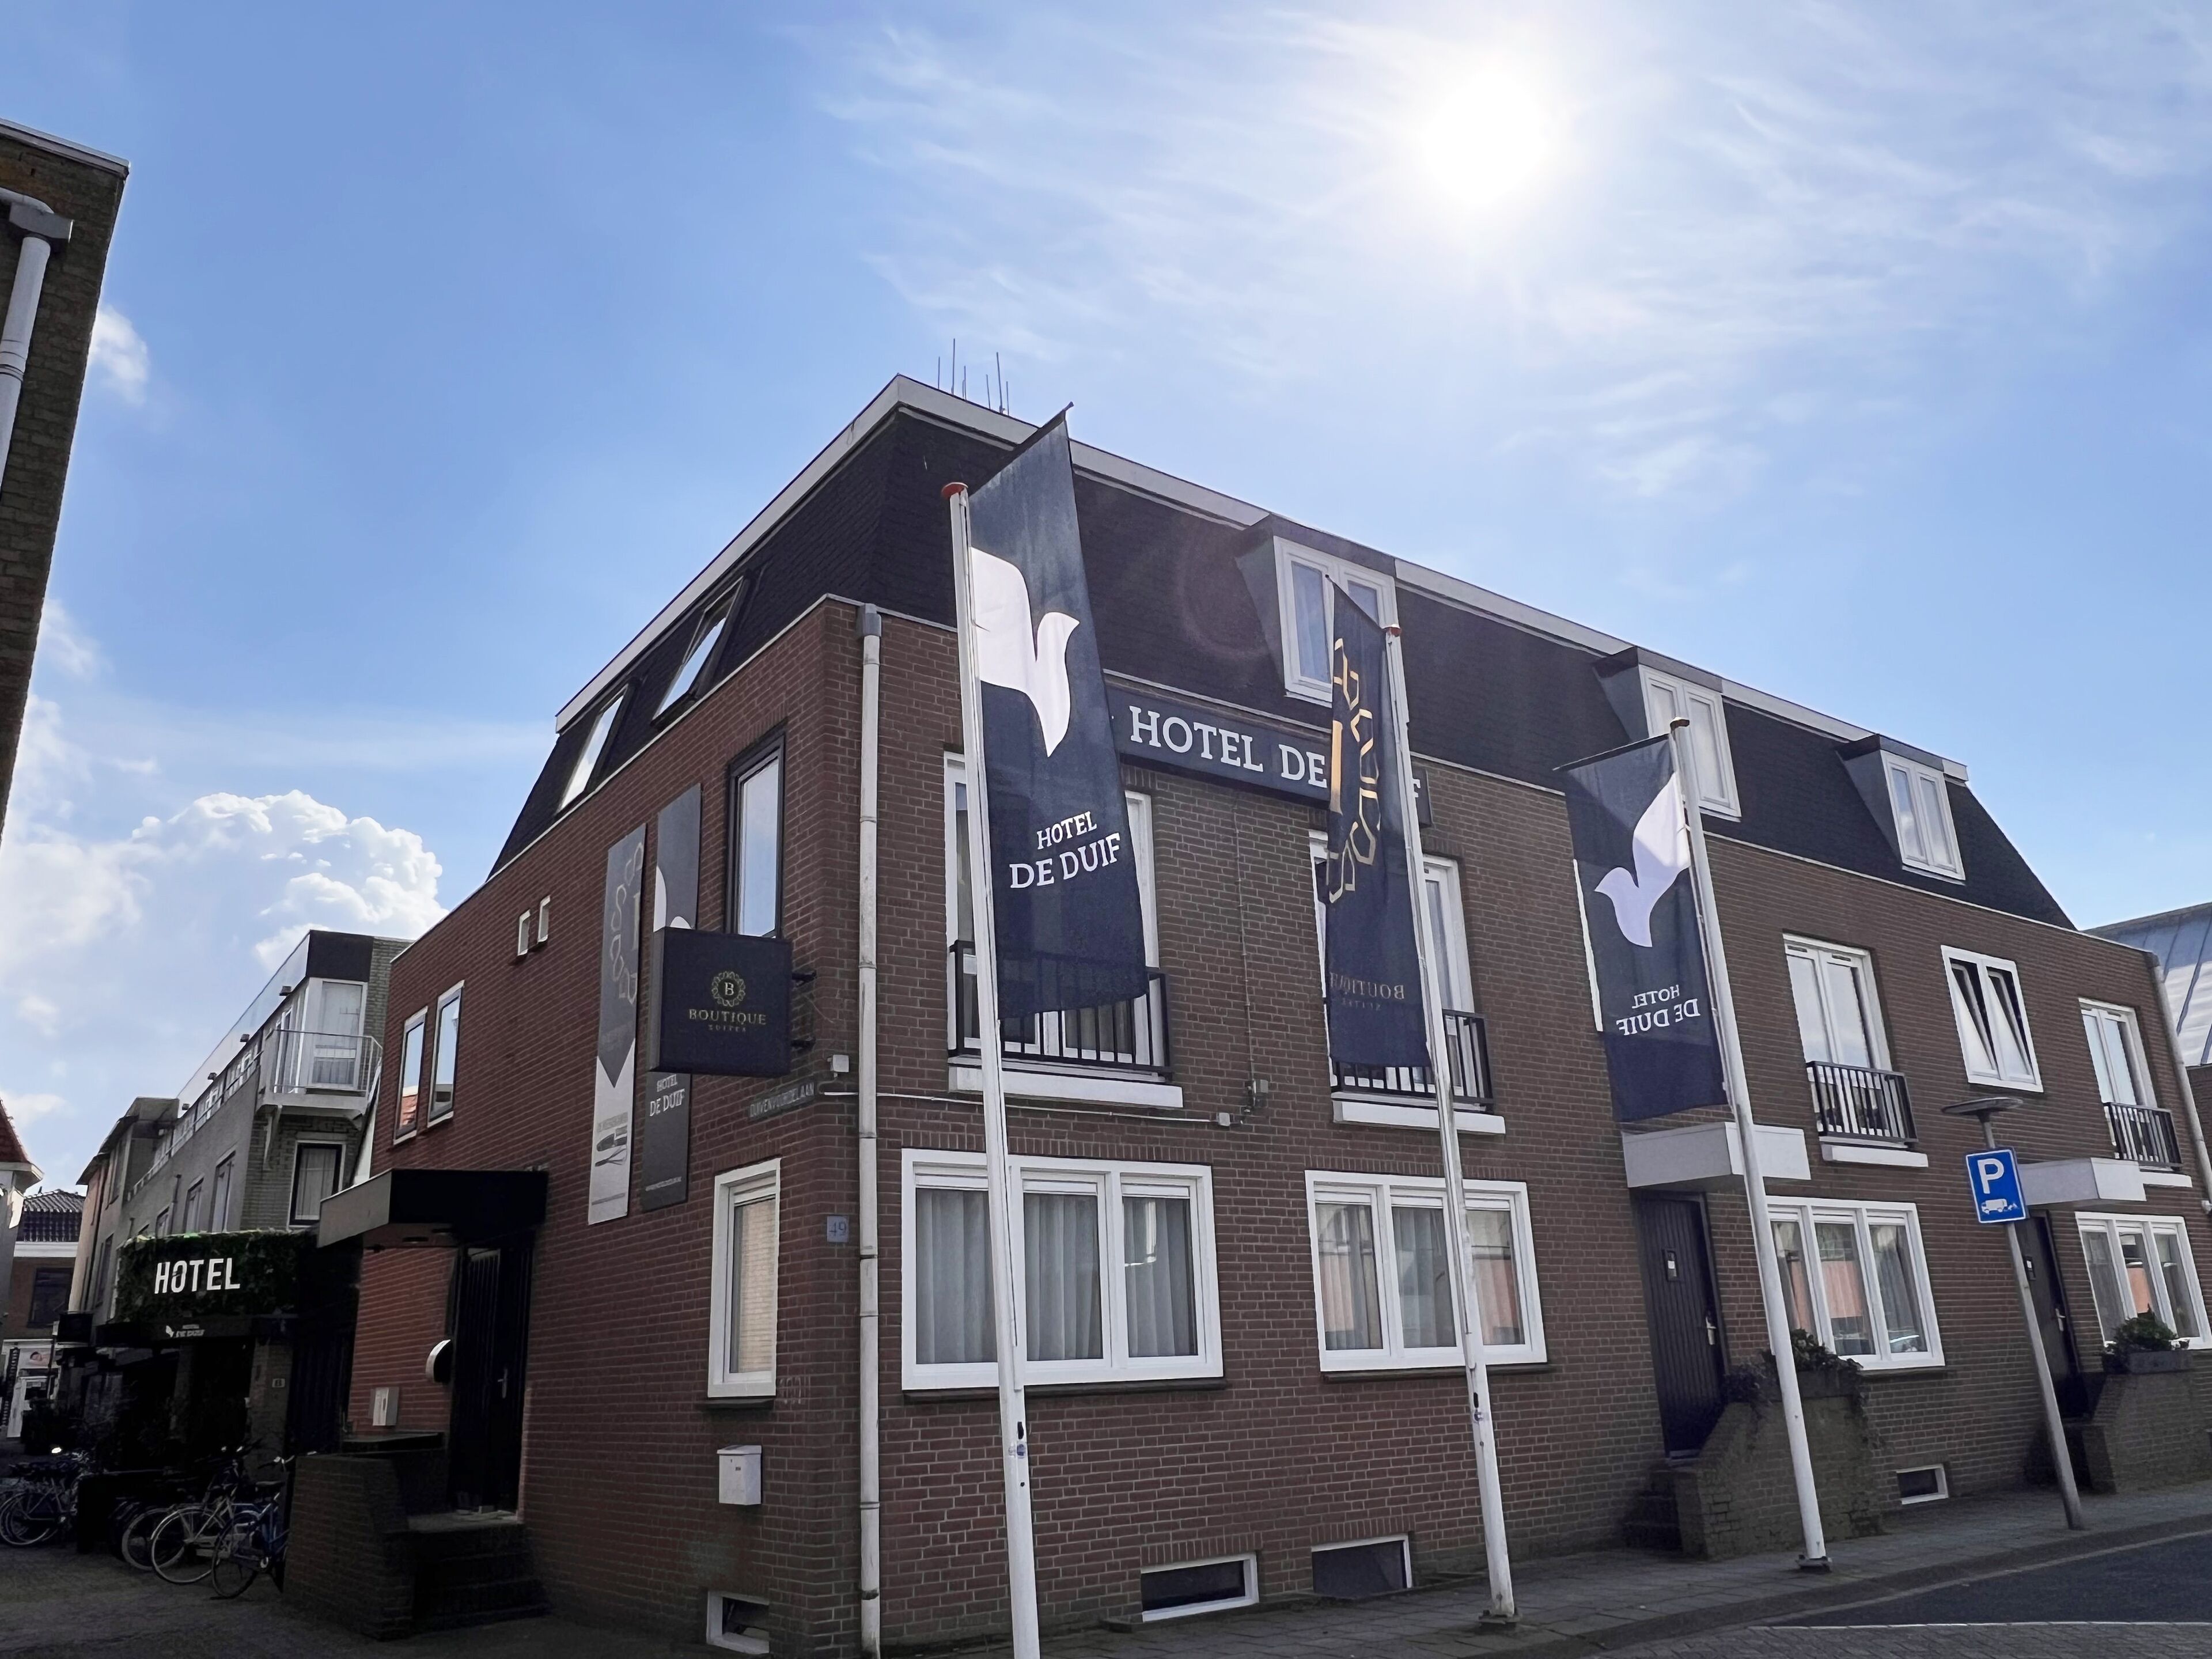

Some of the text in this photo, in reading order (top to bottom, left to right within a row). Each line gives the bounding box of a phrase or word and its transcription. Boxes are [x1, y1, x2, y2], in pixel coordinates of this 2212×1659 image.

[1129, 706, 1328, 788] HOTEL DE
[1037, 811, 1097, 850] HOTEL
[1009, 832, 1120, 888] DE DUIF
[724, 982, 734, 995] B
[689, 1009, 766, 1025] BOUTIQUE
[650, 1088, 685, 1116] DE DUIF
[1978, 1158, 2005, 1194] P
[154, 1257, 240, 1294] HOTEL
